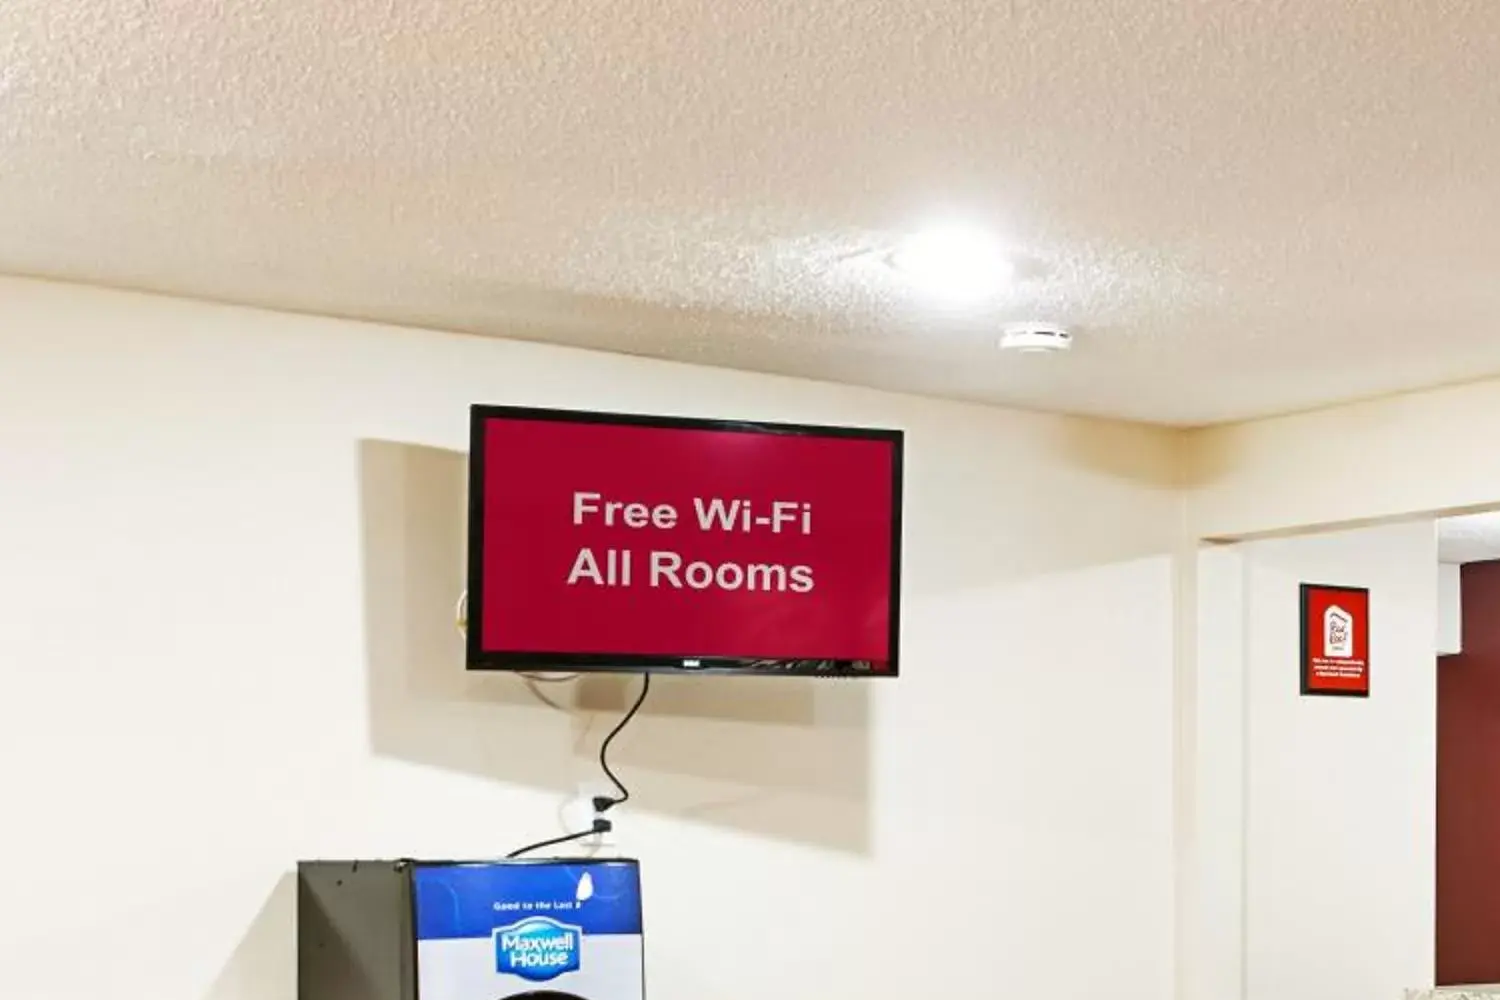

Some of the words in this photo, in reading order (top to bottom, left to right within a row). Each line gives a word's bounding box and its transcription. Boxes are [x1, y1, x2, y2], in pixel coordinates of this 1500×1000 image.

[573, 492, 678, 529] Free
[694, 497, 812, 535] Wi-Fi
[567, 547, 631, 586] All
[651, 551, 815, 594] Rooms
[493, 901, 521, 911] Good
[535, 901, 551, 910] the
[502, 933, 573, 951] Maxwell
[510, 950, 569, 968] House
